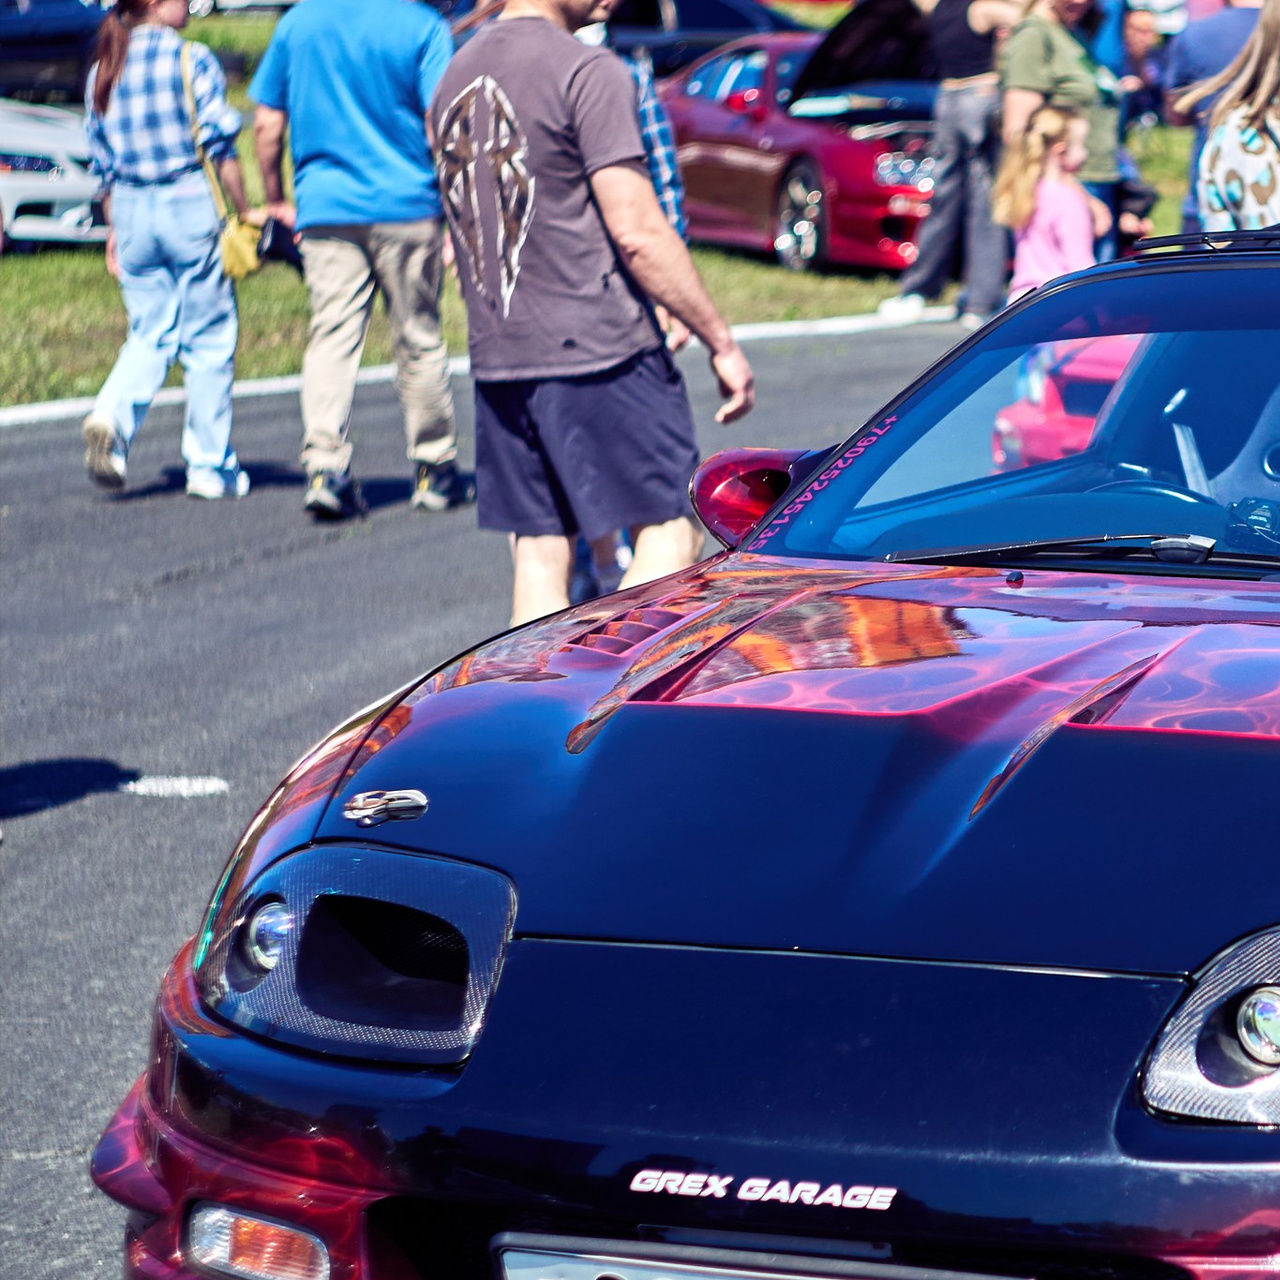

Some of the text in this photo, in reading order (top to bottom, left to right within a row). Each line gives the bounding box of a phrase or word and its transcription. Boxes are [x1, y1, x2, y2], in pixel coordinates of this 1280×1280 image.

[747, 414, 898, 551] +79025245135
[629, 1170, 898, 1210] GREX GARAGE
